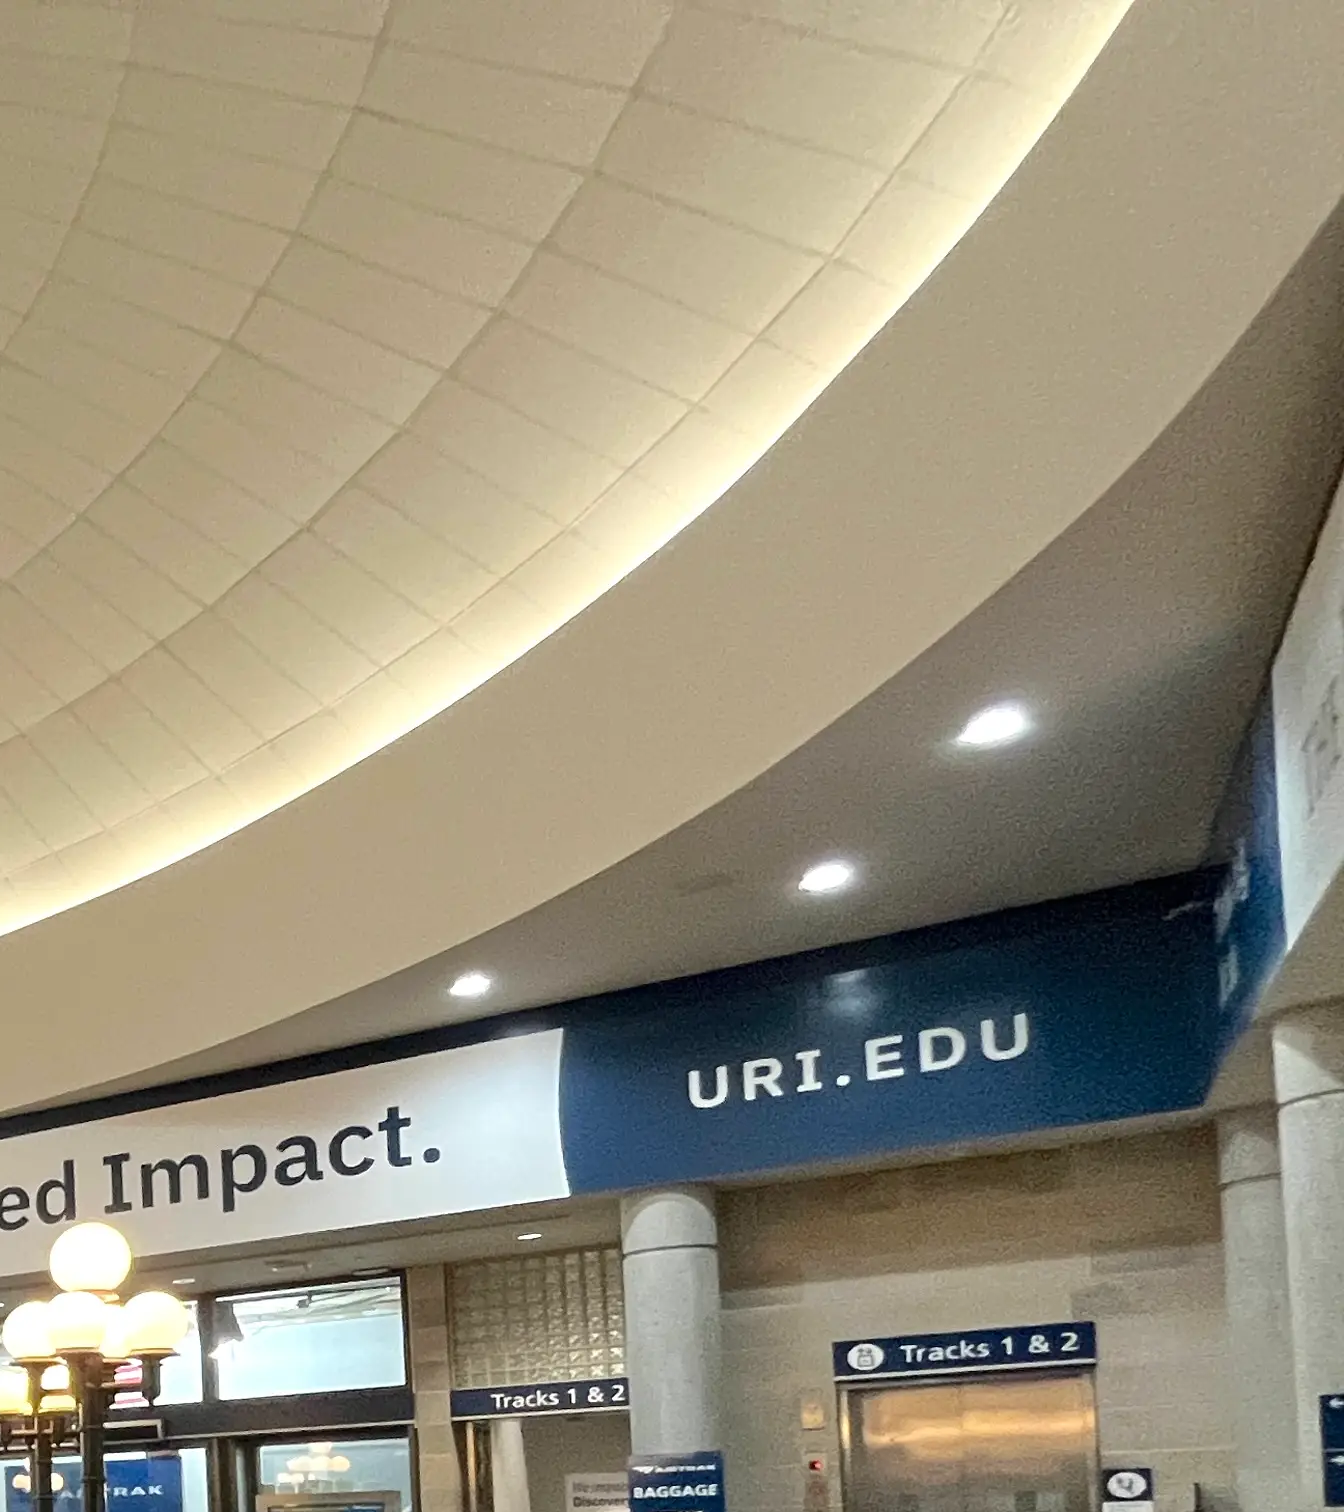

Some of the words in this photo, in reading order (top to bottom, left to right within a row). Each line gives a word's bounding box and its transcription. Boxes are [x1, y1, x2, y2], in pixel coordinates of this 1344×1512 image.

[687, 1012, 1030, 1110] URI.EDU
[103, 1106, 441, 1213] Impact.
[900, 1339, 990, 1365] Tracks
[1001, 1336, 1014, 1356] 1
[1028, 1334, 1051, 1355] &
[1060, 1332, 1080, 1353] 2
[491, 1389, 560, 1410] Tracks
[567, 1388, 577, 1405] 1
[587, 1387, 605, 1404] &
[611, 1385, 626, 1402] 2
[60, 1484, 164, 1500] ARAK
[632, 1483, 718, 1499] BAGGAGE
